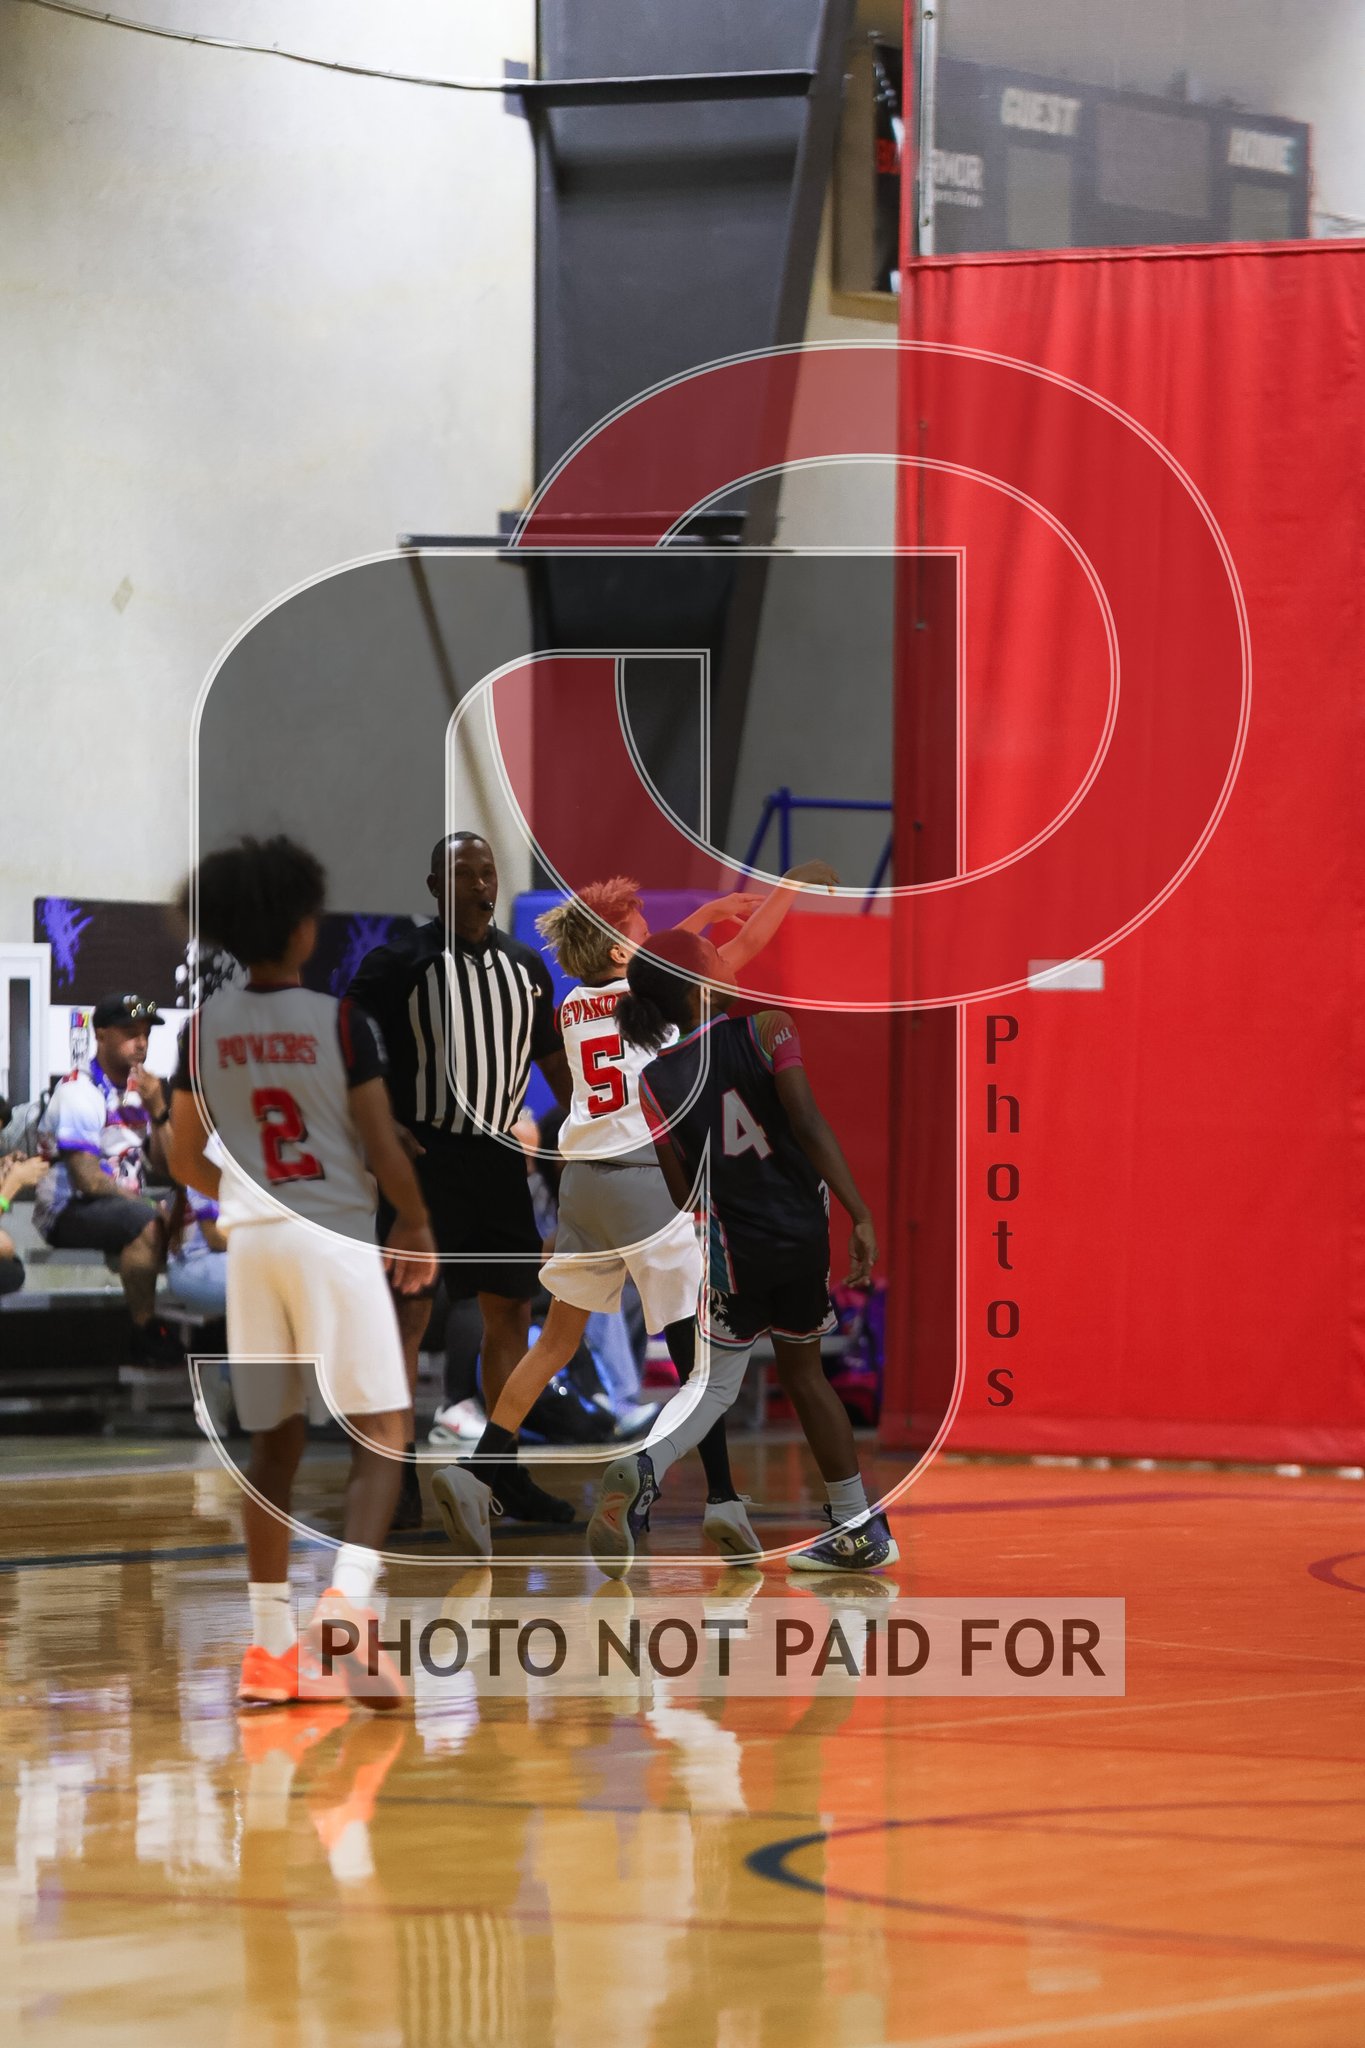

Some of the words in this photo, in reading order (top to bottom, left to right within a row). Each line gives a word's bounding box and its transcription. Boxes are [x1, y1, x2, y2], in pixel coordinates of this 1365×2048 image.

[581, 1034, 629, 1119] 5
[252, 1087, 325, 1185] 2
[722, 1088, 772, 1160] 4
